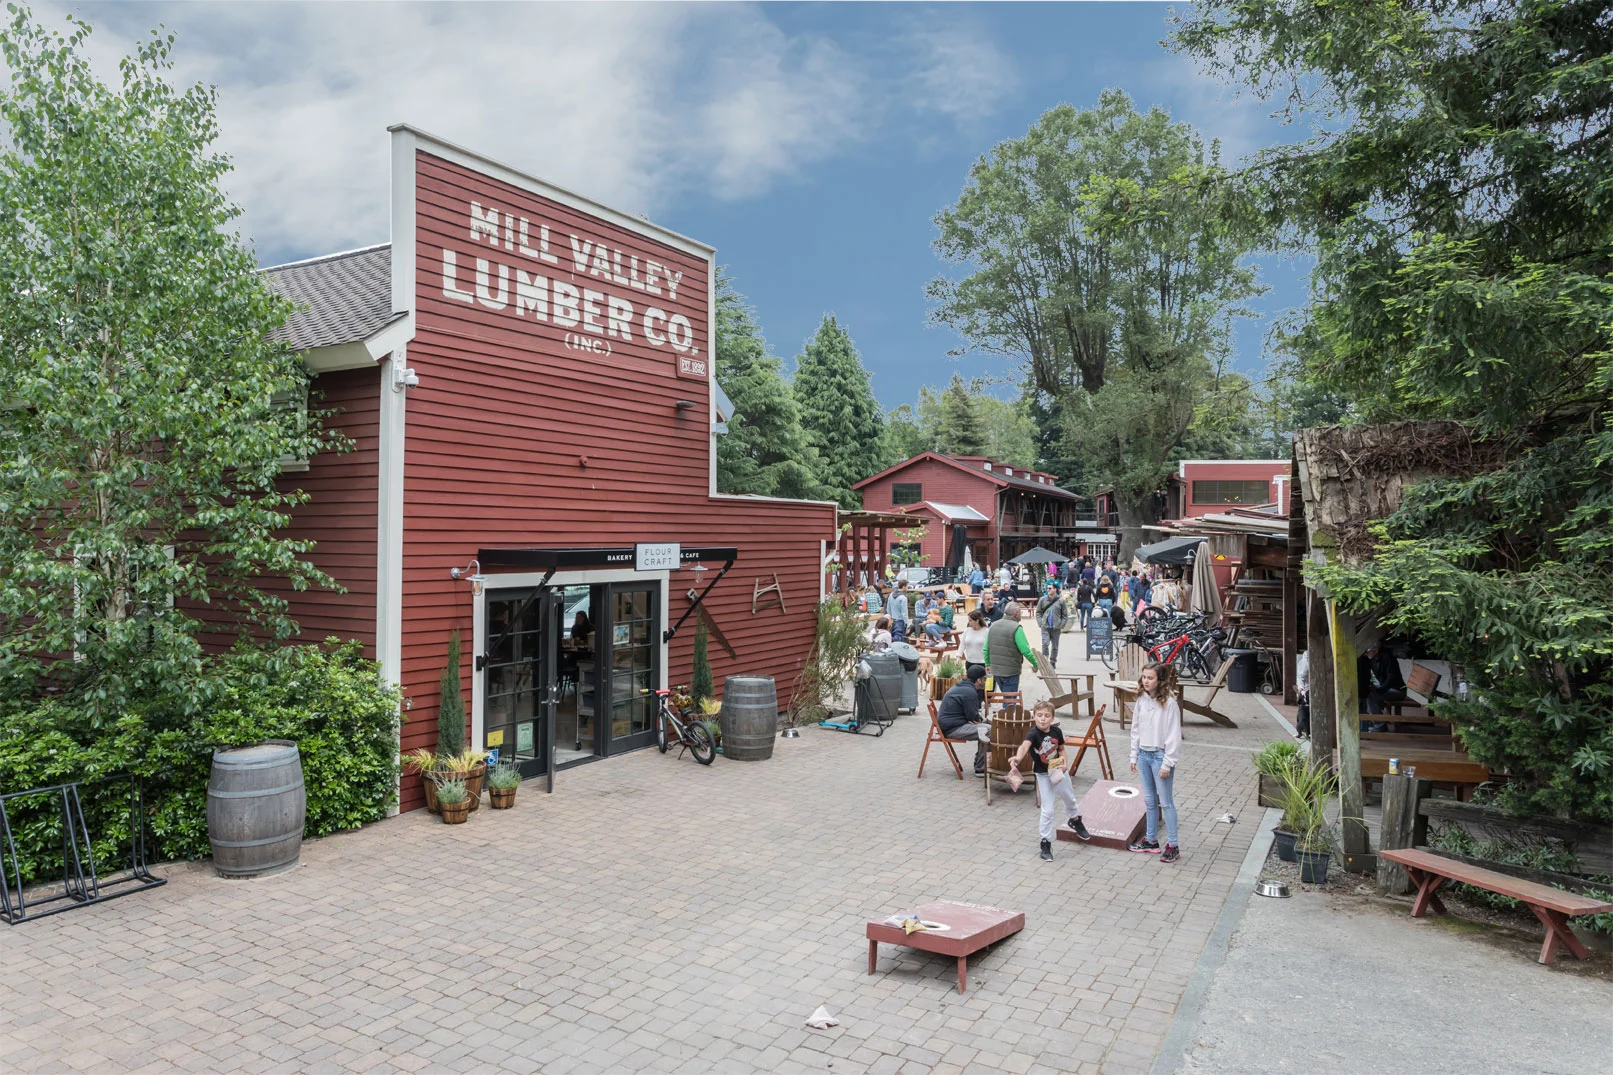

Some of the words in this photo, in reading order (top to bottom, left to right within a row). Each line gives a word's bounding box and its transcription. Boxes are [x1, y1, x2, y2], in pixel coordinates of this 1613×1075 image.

[470, 201, 558, 264] MILL
[570, 235, 683, 299] VALLEY
[442, 249, 634, 341] LUMBER
[564, 332, 612, 357] (INC.)
[643, 557, 672, 566] CRAFT
[644, 548, 672, 556] FLOUR
